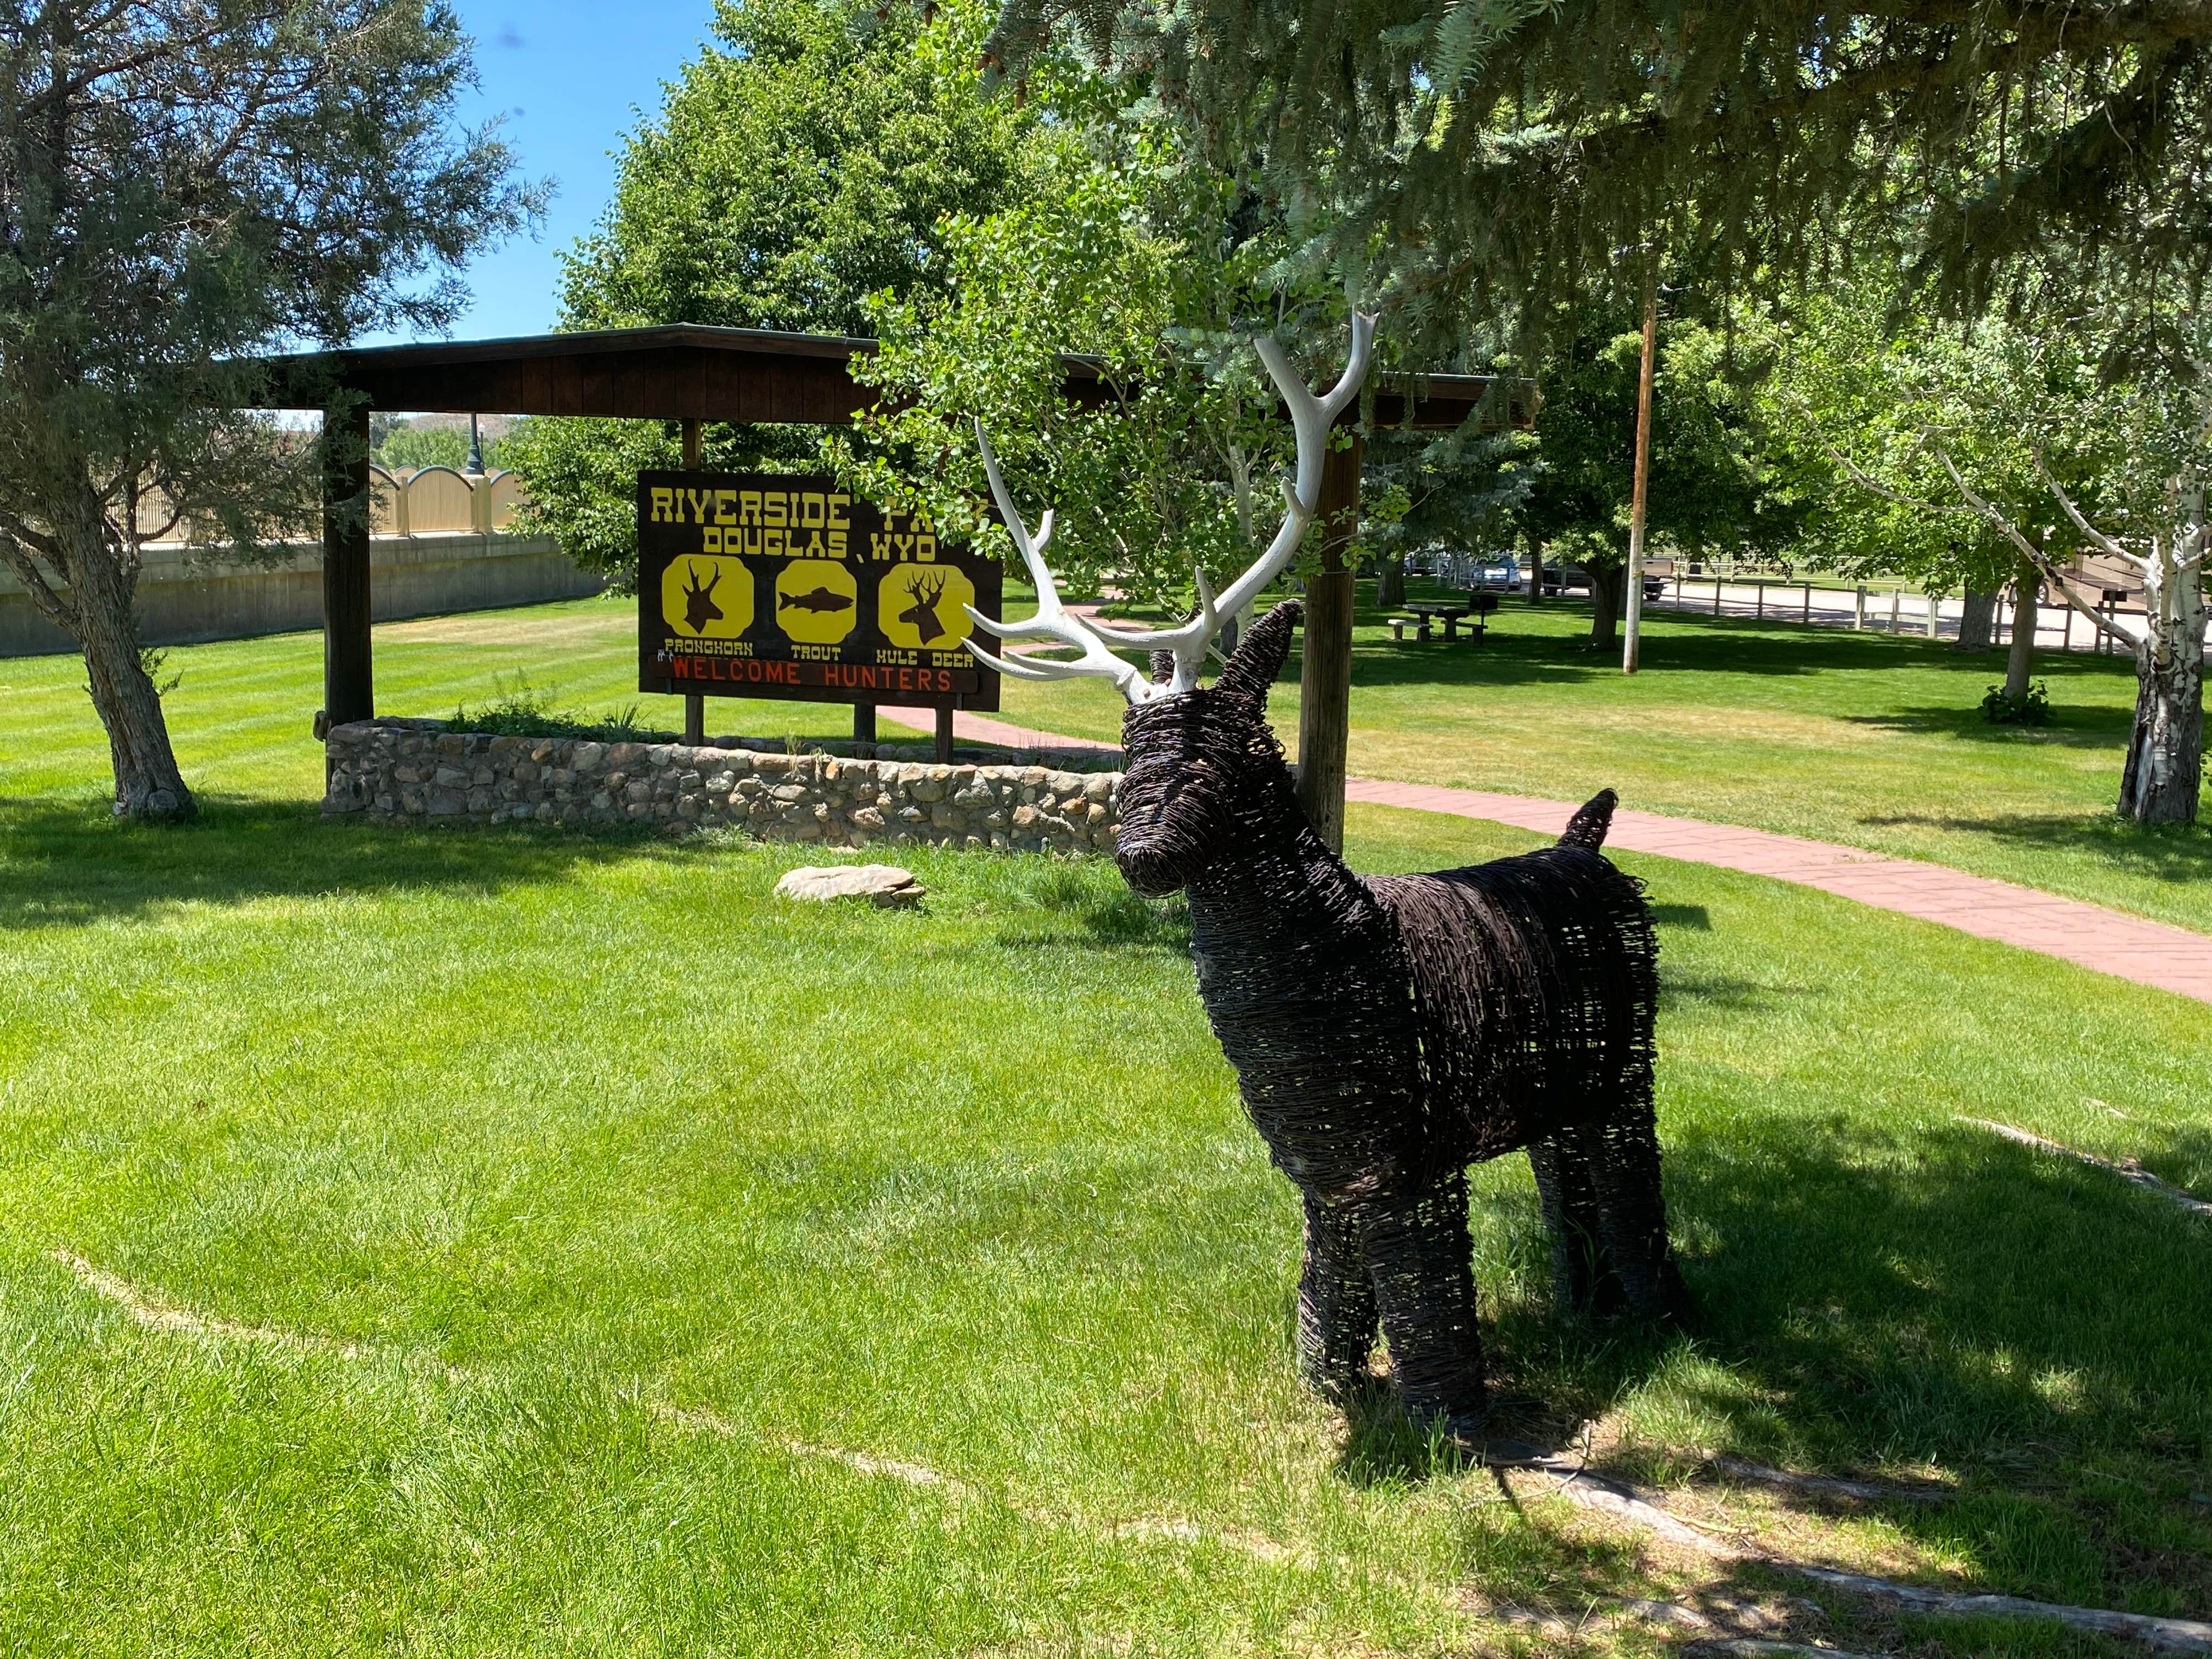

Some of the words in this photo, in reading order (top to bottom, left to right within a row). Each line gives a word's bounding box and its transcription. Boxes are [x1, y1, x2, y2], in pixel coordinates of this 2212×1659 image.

[651, 487, 850, 529] RIVERSIDE
[870, 532, 936, 562] WYO
[664, 638, 753, 656] PRONGHORN
[791, 645, 841, 661] TROUT
[876, 649, 918, 665] MULE
[932, 652, 974, 668] DEER
[673, 657, 801, 685] WELCOME
[825, 664, 951, 691] HUNTERS
